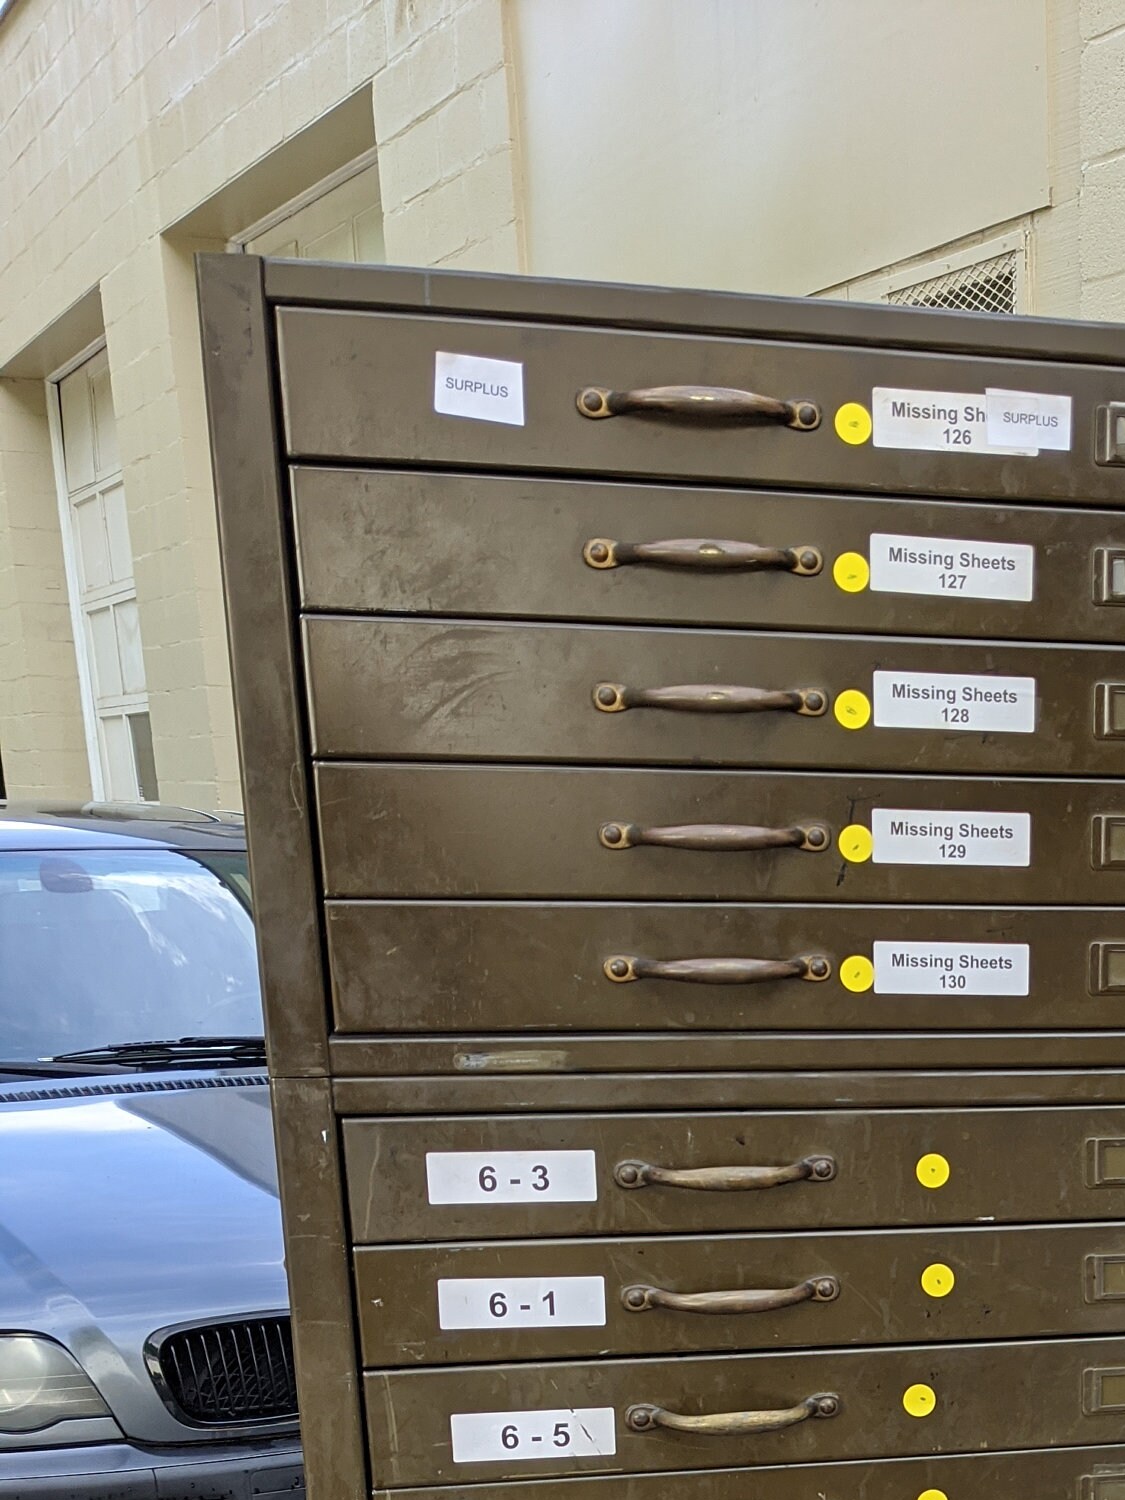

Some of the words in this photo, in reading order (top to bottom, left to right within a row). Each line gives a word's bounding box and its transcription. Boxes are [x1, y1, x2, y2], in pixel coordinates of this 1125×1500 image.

[445, 375, 509, 399] SURPLUS
[891, 401, 958, 424] Missing
[1003, 411, 1058, 428] SURPLUS
[943, 428, 972, 445] 126
[889, 547, 954, 568] Missing
[959, 554, 1016, 571] Sheets
[938, 573, 967, 591] 127
[892, 684, 957, 705] Missing
[961, 689, 1017, 704] Sheets
[940, 707, 969, 724] 128
[890, 821, 955, 841] Missing
[959, 824, 1014, 840] Sheets
[938, 843, 967, 860] 129
[891, 953, 955, 973] Missing
[959, 955, 1013, 971] Sheets
[938, 974, 967, 990] 130
[477, 1166, 497, 1192] 6
[531, 1164, 551, 1191] 3
[488, 1292, 507, 1317] 6
[541, 1291, 556, 1316] 1
[500, 1425, 519, 1449] 6
[552, 1423, 571, 1447] 5
